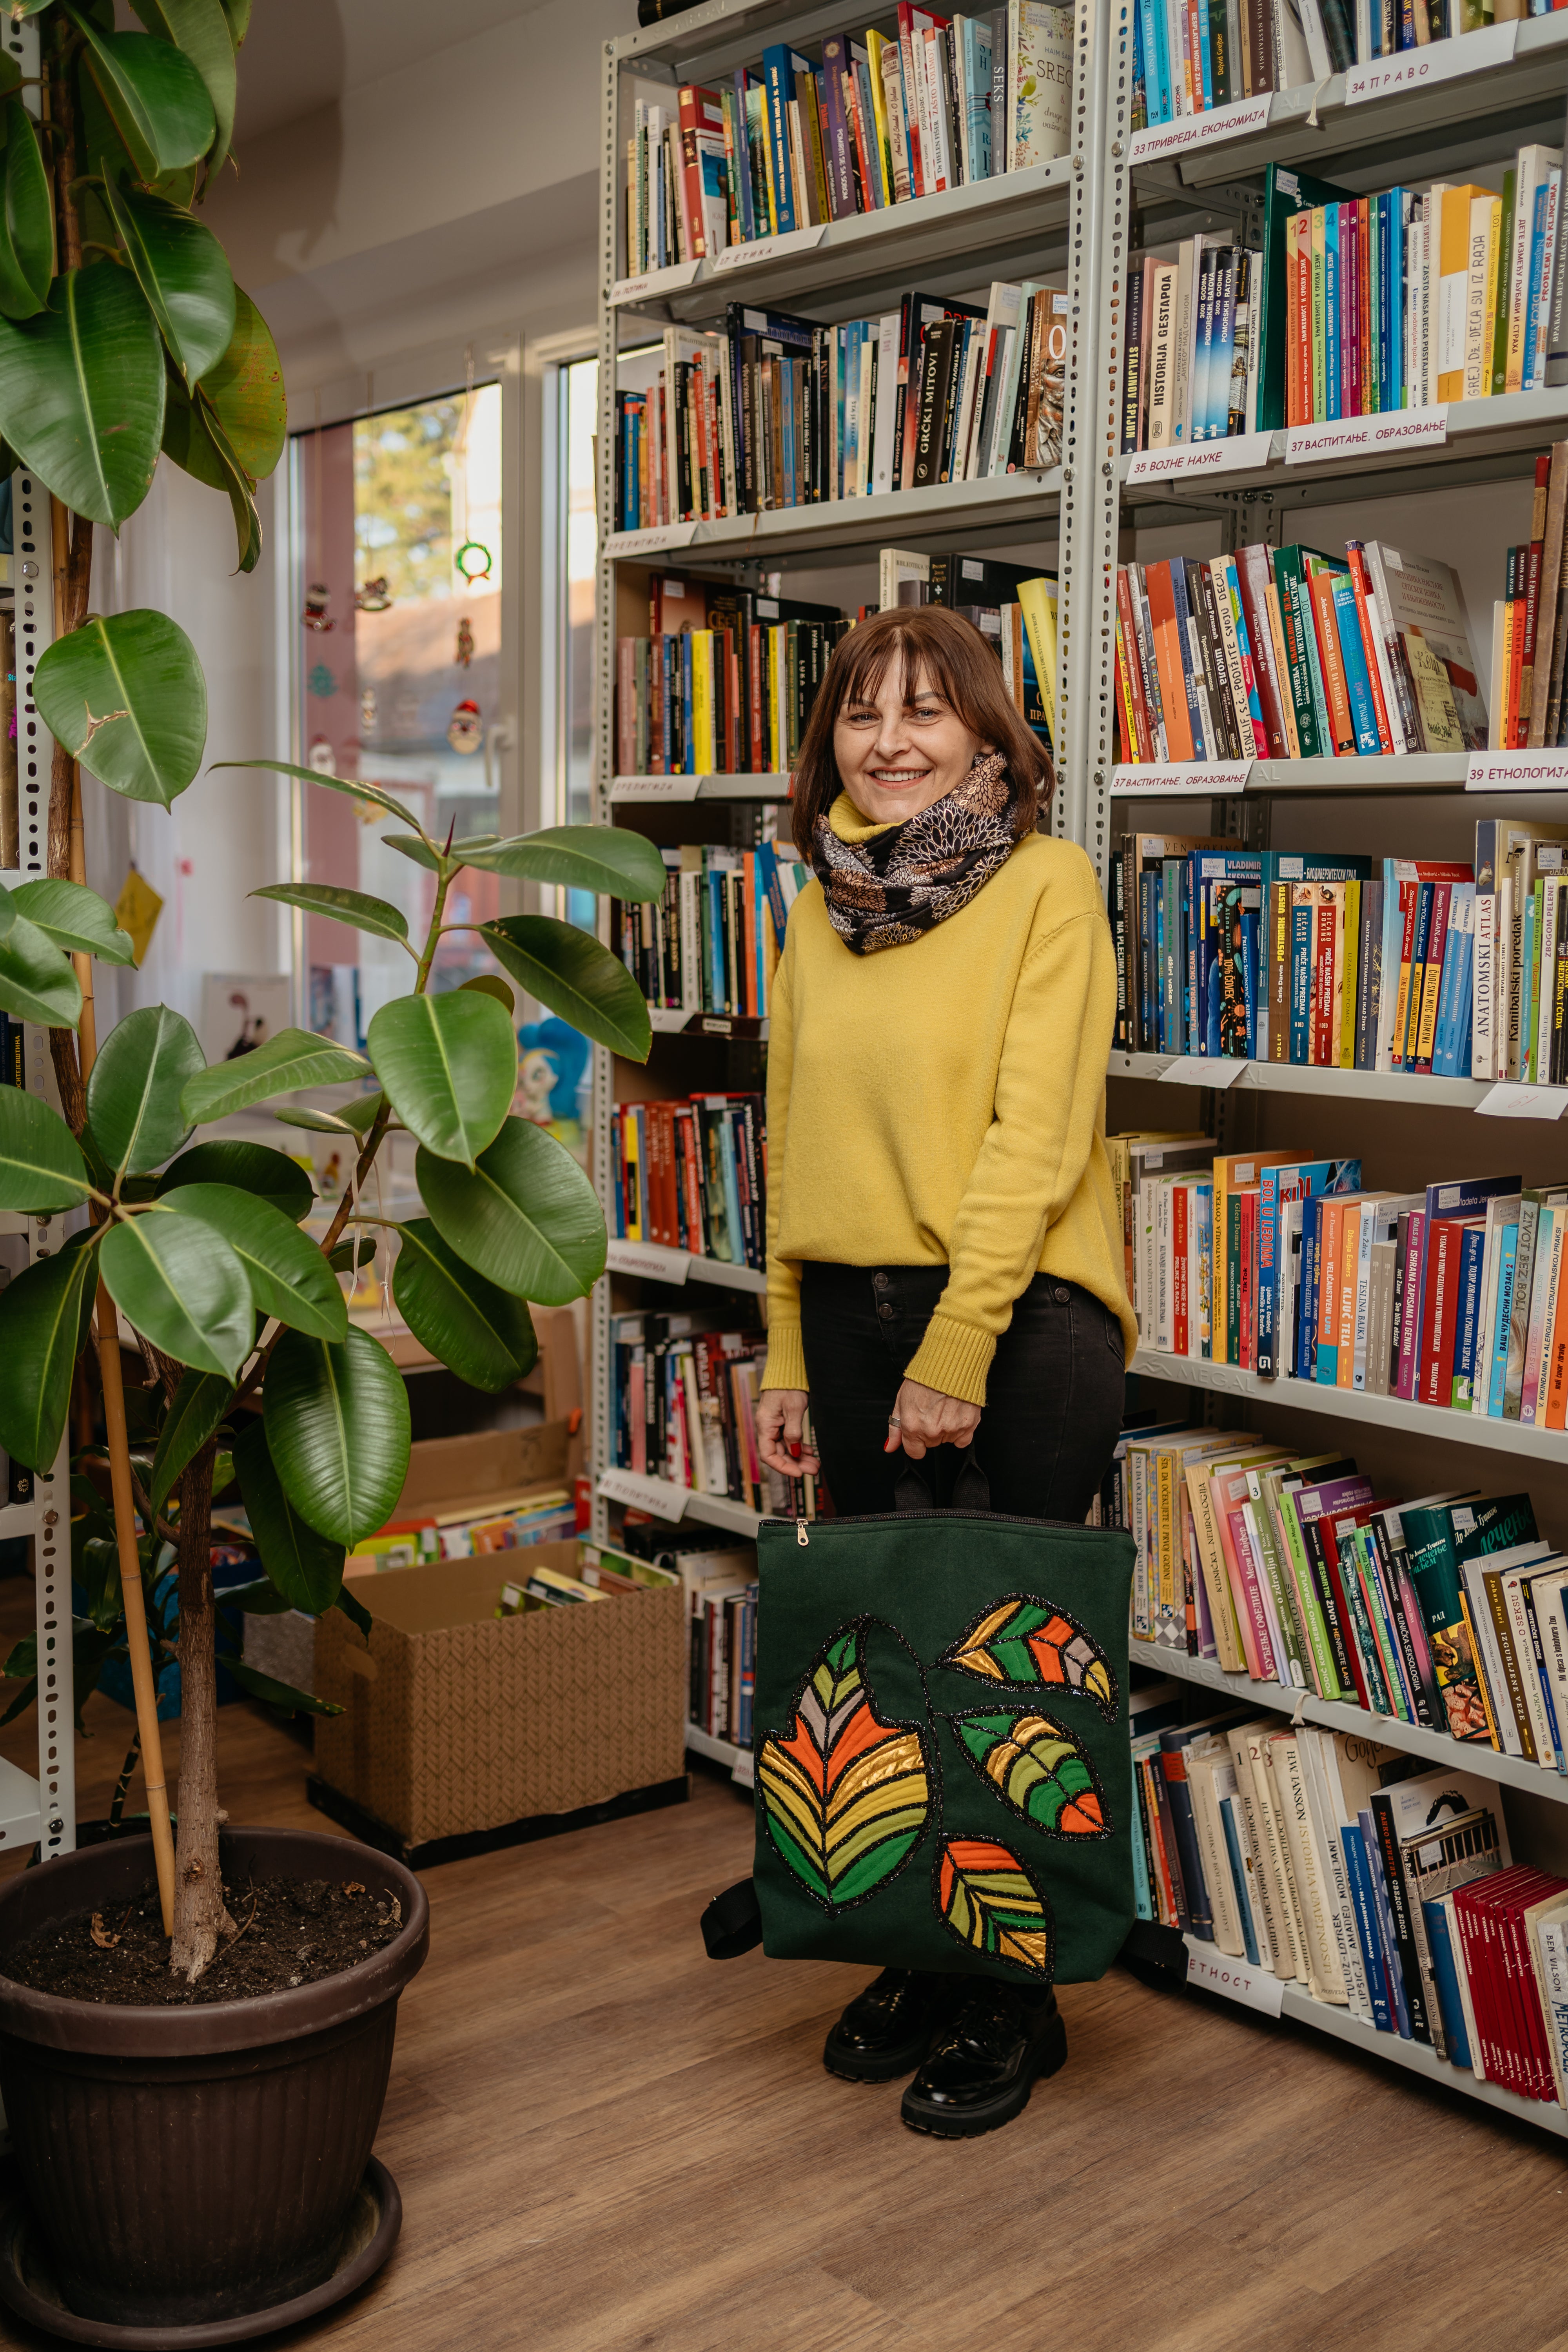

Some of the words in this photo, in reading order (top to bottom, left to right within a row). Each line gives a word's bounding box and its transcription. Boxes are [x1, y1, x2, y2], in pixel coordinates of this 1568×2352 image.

[993, 66, 1004, 103] SEKS
[1036, 59, 1073, 88] SREĆ
[1352, 81, 1365, 94] 34
[1044, 108, 1063, 123] druge
[1134, 144, 1145, 155] 33
[1299, 219, 1307, 234] 2
[1541, 253, 1551, 301] PROBLEMI
[1548, 183, 1557, 230] KLINCIMA
[733, 247, 773, 261] ЕТИКА
[1472, 235, 1485, 267] RAJA
[1158, 274, 1172, 337] GESTAPOA
[1204, 301, 1212, 346] POMORSKIH
[1470, 310, 1481, 338] DECA
[1553, 303, 1562, 342] ВРАЋАЊЕ
[925, 351, 938, 405] MITOVI
[1128, 347, 1138, 398] STALJINOV
[1154, 343, 1167, 406] HISTORIJA
[920, 408, 931, 454] GRČKI
[1126, 403, 1138, 438] ŠPIJUN
[1291, 441, 1303, 452] 37
[1305, 432, 1371, 450] ВАСПИТАЊЕ.
[1375, 420, 1446, 441] ОБРАЗОВАЊЕ
[1134, 463, 1147, 473] 35
[1150, 457, 1185, 471] ВОЈНЕ
[1187, 452, 1223, 466] НАУКЕ
[1394, 570, 1422, 584] МЕТОДИКА
[1407, 593, 1445, 611] КЊИЖЕВНОСТИ
[1423, 590, 1441, 600] ЈЕЗИКА
[1323, 619, 1334, 651] HOLCER
[1138, 633, 1147, 675] ЗАГОНЕТКА
[1214, 648, 1227, 685] ШКОЛА
[1292, 666, 1303, 707] ТУМАЧЕЊА
[1373, 689, 1383, 724] НАЈВАЖНИЈИХ
[1379, 725, 1387, 736] 10
[1126, 777, 1181, 786] ВАСПИТАЊЕ.
[1186, 774, 1245, 784] ОБРАЗОВАЊЕ
[1470, 769, 1484, 780] 39
[1345, 869, 1357, 880] ГРАД
[1481, 899, 1492, 940] ATLAS
[1277, 916, 1285, 962] POSTANAK
[1512, 914, 1524, 968] poredak
[1224, 959, 1232, 975] 10%
[1428, 969, 1439, 995] ČUDESNA
[1224, 976, 1234, 1000] ČOVEK
[1441, 964, 1450, 1018] ЕНЦИКЛОПЕДИЈА
[1477, 944, 1490, 1037] ANATOMSKI
[1508, 972, 1521, 1042] Kanibalski
[1422, 1014, 1432, 1044] HORMONA
[1262, 1180, 1274, 1203] BOL
[1261, 1220, 1273, 1269] LEĐIMA
[1521, 1210, 1536, 1251] ŽIVOT
[1439, 1234, 1448, 1260] НЕУРОЗА
[1408, 1249, 1418, 1280] ISHRANA
[1325, 1261, 1334, 1315] VELIČANSTVENI
[1359, 1279, 1367, 1307] TESLINA
[1504, 1271, 1513, 1294] МОЗАК
[1515, 1283, 1526, 1311] BOLI
[1342, 1287, 1352, 1319] KLJUČ
[1501, 1295, 1510, 1331] ЧУДЕСНИ
[1403, 1327, 1412, 1356] GENIMA
[1199, 1482, 1215, 1548] NEUROLOGIJA
[1299, 1569, 1314, 1609] ZDRAVLJE
[1249, 1585, 1265, 1630] ОФЕЛИЈЕ
[1318, 1561, 1331, 1598] BESMRTNI
[1333, 1628, 1347, 1666] HENRIJETE
[1341, 1667, 1351, 1686] LAKS
[1432, 1611, 1446, 1624] РАД
[1527, 1608, 1539, 1638] SINTETIČKE
[1307, 1611, 1322, 1642] BEBINO
[1258, 1631, 1274, 1670] БУЂЕЊЕ
[1396, 1612, 1410, 1645] KLINIČKA
[1404, 1644, 1421, 1691] SEKSOLOGIJA
[1501, 1632, 1519, 1693] IZGUBLJENE
[1532, 1639, 1542, 1661] DROGE
[1319, 1668, 1332, 1694] VODIČ
[1292, 1780, 1307, 1821] JANSON
[1312, 1888, 1333, 1975] UMETNOSTI
[1327, 1840, 1347, 1900] MODILJANI
[1380, 1811, 1389, 1837] РАНКО
[1392, 1879, 1403, 1914] СВЕДОК
[1189, 1959, 1251, 1991] ЕТНОСТ
[1546, 1935, 1555, 1953] BEN
[1551, 1957, 1561, 1992] VILSON
